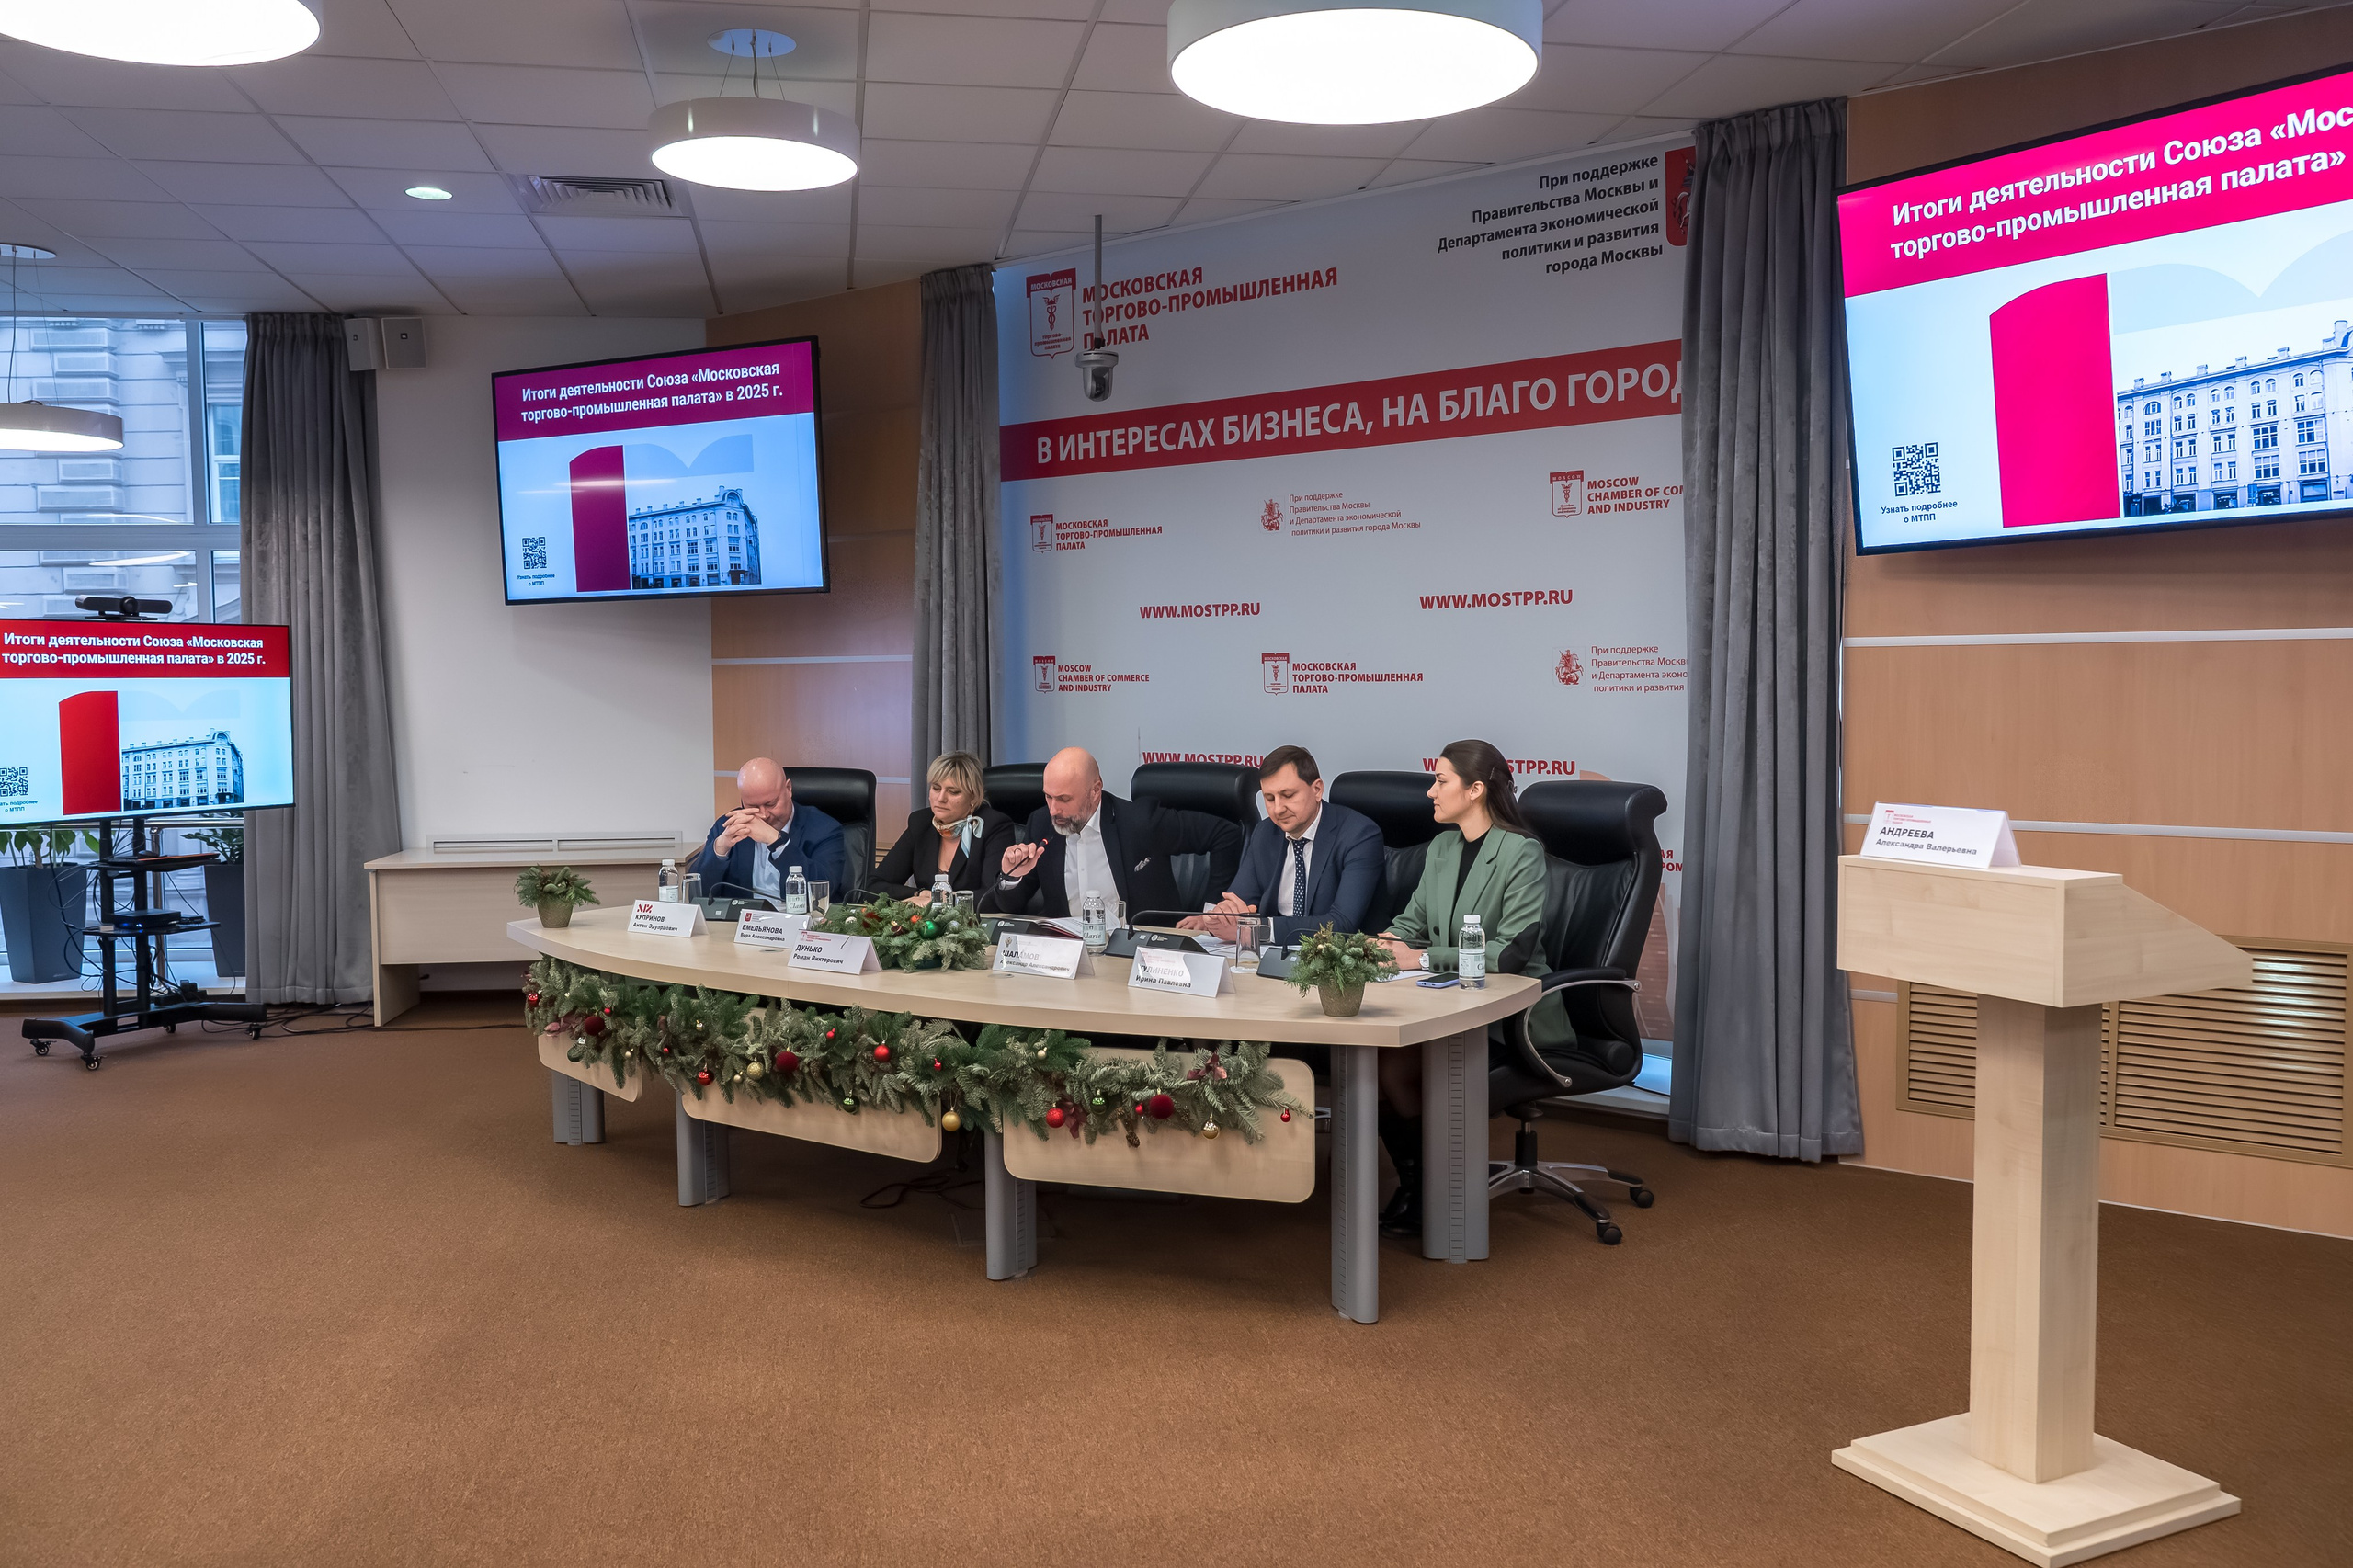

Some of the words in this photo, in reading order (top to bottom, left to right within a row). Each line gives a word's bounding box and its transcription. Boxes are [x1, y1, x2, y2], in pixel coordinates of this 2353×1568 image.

[1539, 174, 1568, 190] При
[1572, 156, 1659, 183] поддержке
[1893, 192, 1963, 226] Итоги
[1969, 151, 2156, 214] деятельности
[2163, 124, 2262, 166] Союза
[1472, 194, 1580, 223] Правительства
[1584, 180, 1646, 203] Москвы
[1648, 178, 1659, 189] и
[1890, 173, 2213, 260] торгово-промышленная
[2221, 150, 2347, 191] палата»
[1438, 223, 1538, 254] Департамента
[1540, 199, 1659, 233] экономической
[1502, 240, 1571, 260] политики
[1574, 236, 1584, 248] и
[1587, 222, 1660, 248] развития
[1545, 256, 1597, 276] города
[1600, 244, 1664, 266] Москвы
[1084, 324, 1149, 351] ПЛАТА
[522, 386, 557, 402] Итоги
[559, 375, 645, 401] деятельности
[646, 370, 689, 389] Союза
[691, 362, 780, 384] «Московская
[521, 394, 669, 424] торгово-промышленная
[671, 391, 722, 408] палата»
[725, 391, 734, 403] в
[736, 383, 769, 400] 2025
[772, 385, 783, 397] г.
[1037, 437, 1052, 464] В
[1059, 418, 1216, 461] ИНТЕРЕСАХ
[1223, 401, 1373, 446] БИЗНЕСА,
[1382, 393, 1430, 428] НА
[1438, 377, 1557, 422] БЛАГО
[1587, 476, 1640, 490] MOSCOW
[1289, 494, 1303, 503] При
[1304, 492, 1344, 503] поддержке
[1587, 488, 1642, 502] CHAMBER
[1644, 487, 1660, 497] OF
[1290, 503, 1341, 514] Правительства
[1342, 501, 1370, 510] Москвы
[1587, 504, 1611, 515] AND
[1614, 499, 1670, 513] INDUSTRY
[1881, 506, 1910, 515] Узнать
[1911, 500, 1958, 512] подробнее
[1055, 519, 1108, 530] МОСКОВСКАЯ
[1295, 514, 1345, 526] Департамента
[1346, 510, 1402, 521] экономической
[1911, 513, 1936, 522] МТПП
[1055, 526, 1163, 540] ТОРГОВО-ПРОМЫШЛЕННАЯ
[1291, 528, 1324, 536] политики
[1331, 526, 1364, 535] развития
[1365, 523, 1391, 533] города
[1392, 521, 1421, 530] Москвы
[1056, 541, 1086, 551] ПАЛАТА
[1419, 589, 1573, 610] WWW.MOSTPP.RU
[1140, 602, 1261, 619] WWW.MOSTPP.RU
[4, 632, 46, 646] Итоги
[48, 634, 140, 648] деятельности
[142, 635, 184, 647] Союза
[186, 636, 264, 649] «Московская
[1591, 646, 1608, 655] При
[1610, 645, 1659, 655] поддержке
[2, 653, 165, 666] торгово-промышленная
[166, 653, 214, 665] палата»
[217, 655, 224, 665] в
[227, 653, 255, 665] 2025
[257, 655, 266, 665] г.
[1292, 662, 1357, 671] МОСКОВСКАЯ
[1591, 658, 1655, 667] Правительства
[1058, 665, 1091, 673] MOSCOW
[1598, 670, 1660, 681] Департамента
[1058, 674, 1094, 682] CHAMBER
[1096, 674, 1105, 682] OF
[1107, 674, 1150, 682] COMMERCE
[1292, 673, 1424, 682] ТОРГОВО-ПРОМЫШЛЕННАЯ
[1058, 684, 1074, 692] AND
[1075, 684, 1111, 692] INDUSTRY
[1292, 685, 1328, 693] ПАЛАТА
[1644, 684, 1685, 693] развития
[1880, 826, 1934, 839] АНДРЕЕВА
[1875, 838, 1924, 850] Александра
[1926, 843, 1977, 855] Валерьевна
[634, 915, 665, 923] КУПРИНОВ
[742, 924, 783, 935] ЕМЕЛЬЯНОВА
[795, 944, 823, 953] ДУНЬКО
[811, 955, 844, 965] Викторович
